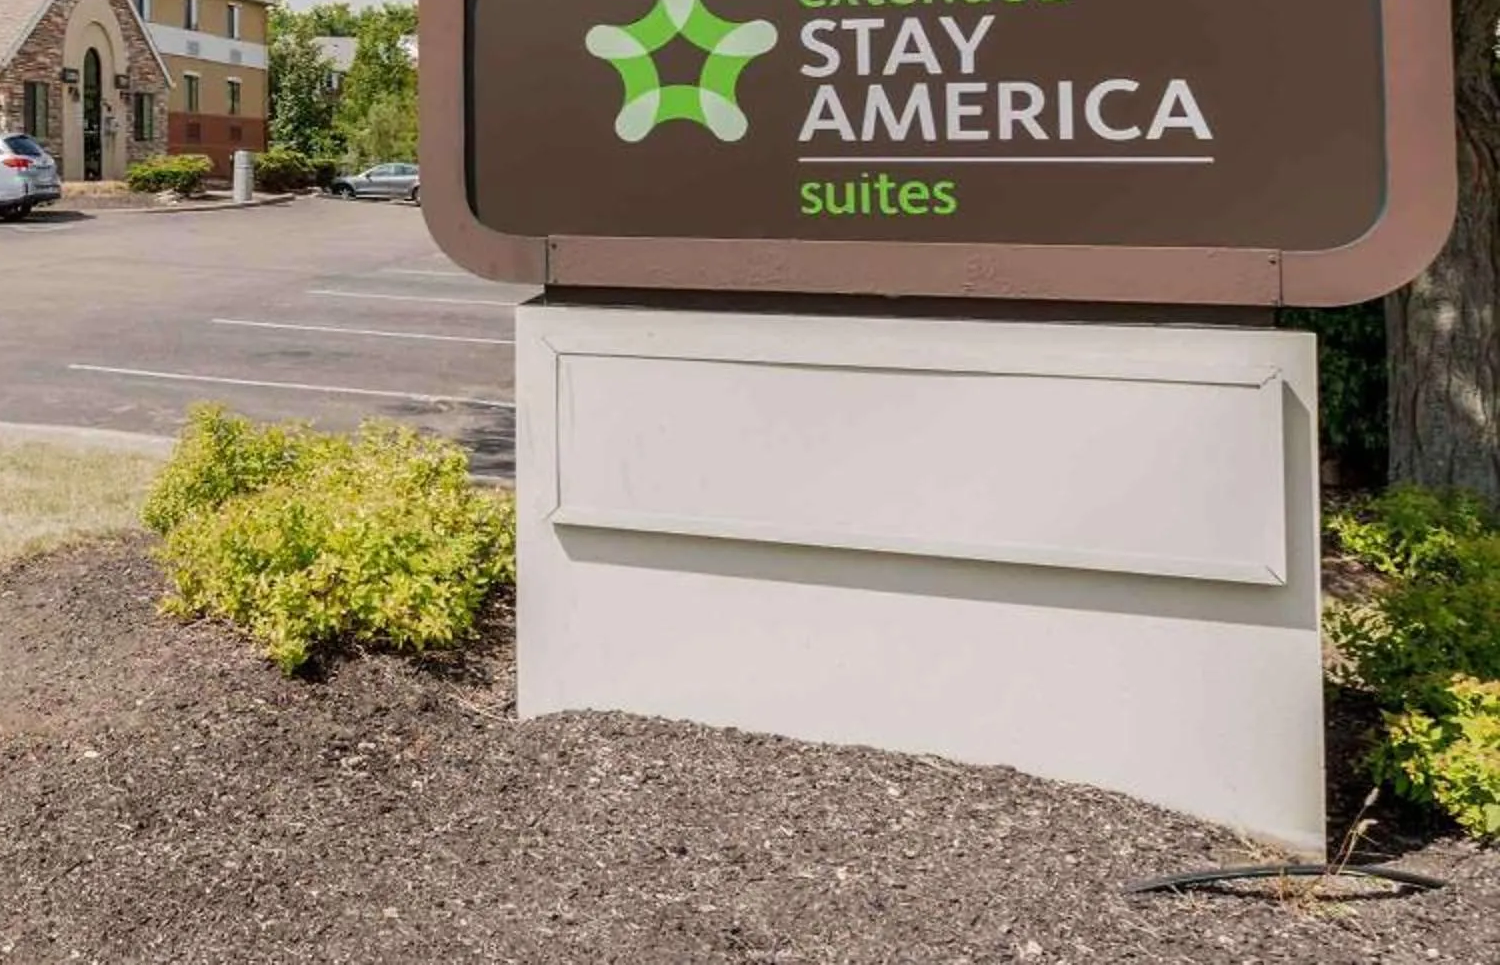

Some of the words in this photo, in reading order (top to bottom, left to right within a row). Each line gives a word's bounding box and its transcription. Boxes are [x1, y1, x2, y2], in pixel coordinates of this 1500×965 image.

[799, 14, 996, 78] STAY
[798, 78, 1214, 142] AMERICA
[800, 169, 957, 215] suites
